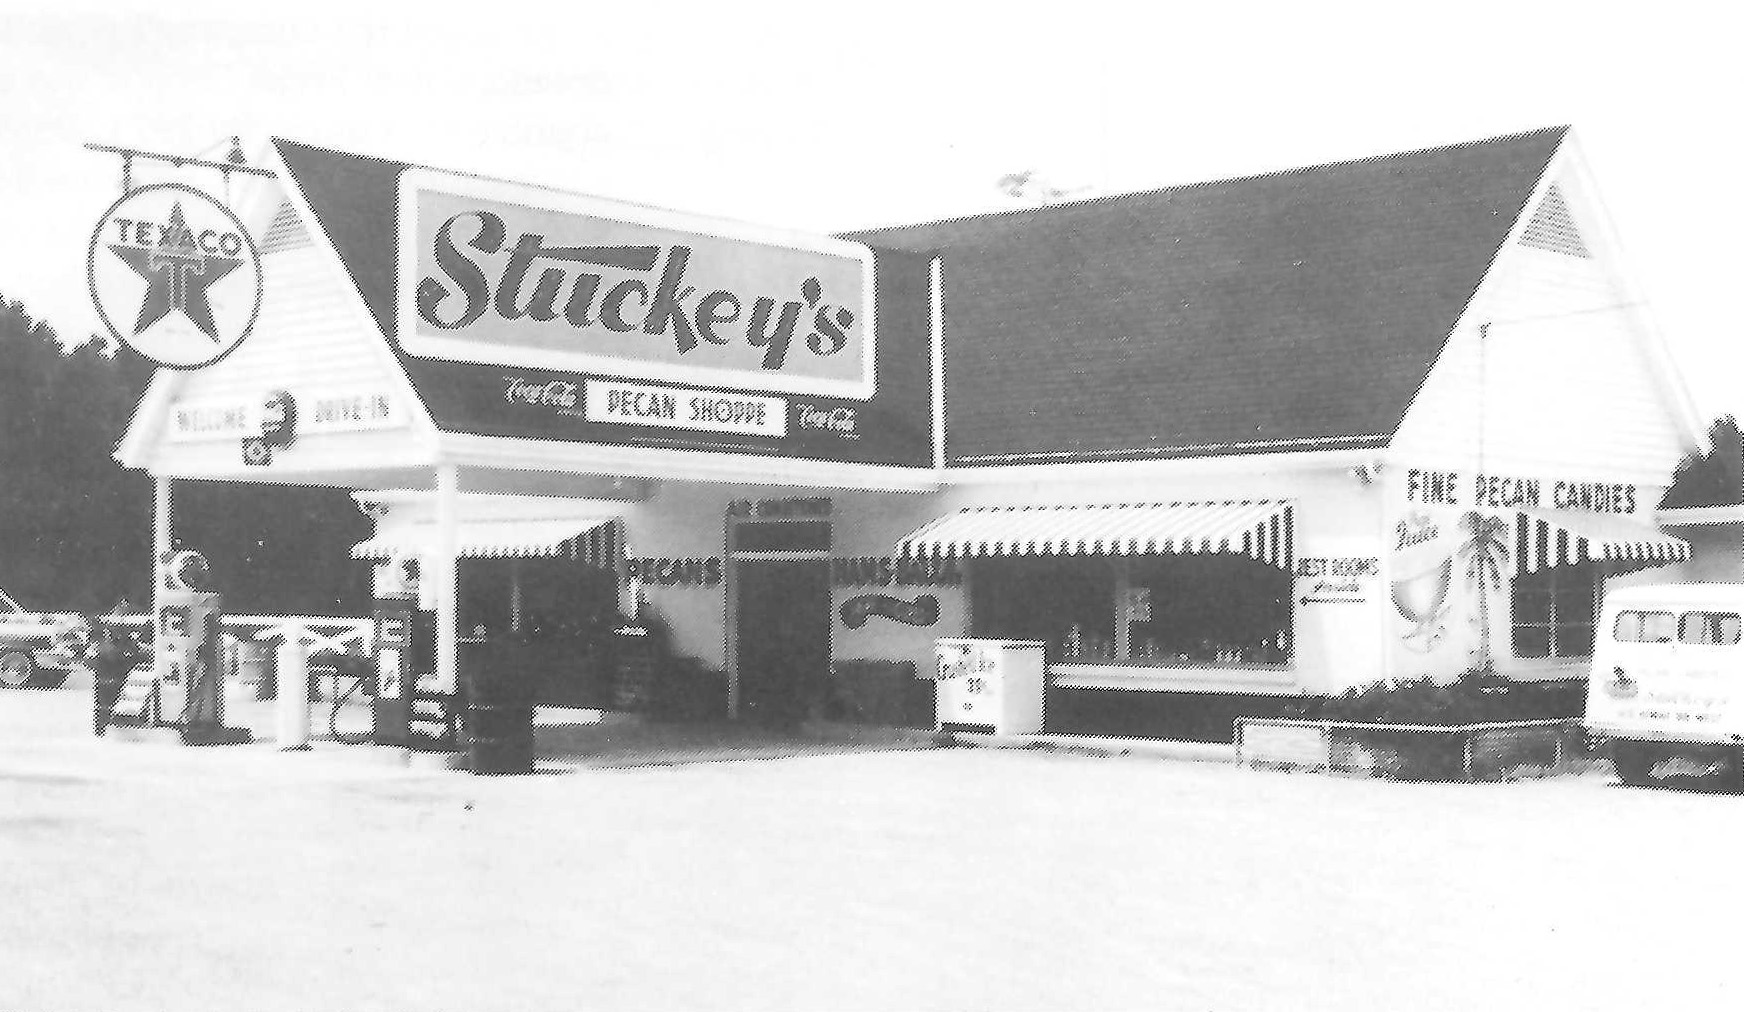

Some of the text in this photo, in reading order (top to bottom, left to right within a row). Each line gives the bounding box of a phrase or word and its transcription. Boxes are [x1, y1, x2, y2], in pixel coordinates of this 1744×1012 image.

[113, 217, 242, 257] TEXACO
[416, 211, 855, 370] Stuckey's
[606, 388, 768, 427] PECAN SHOPPE
[1408, 469, 1637, 515] FINE PECAN CANDIES
[624, 557, 722, 586] PECANS
[1332, 556, 1379, 577] ROOMS
